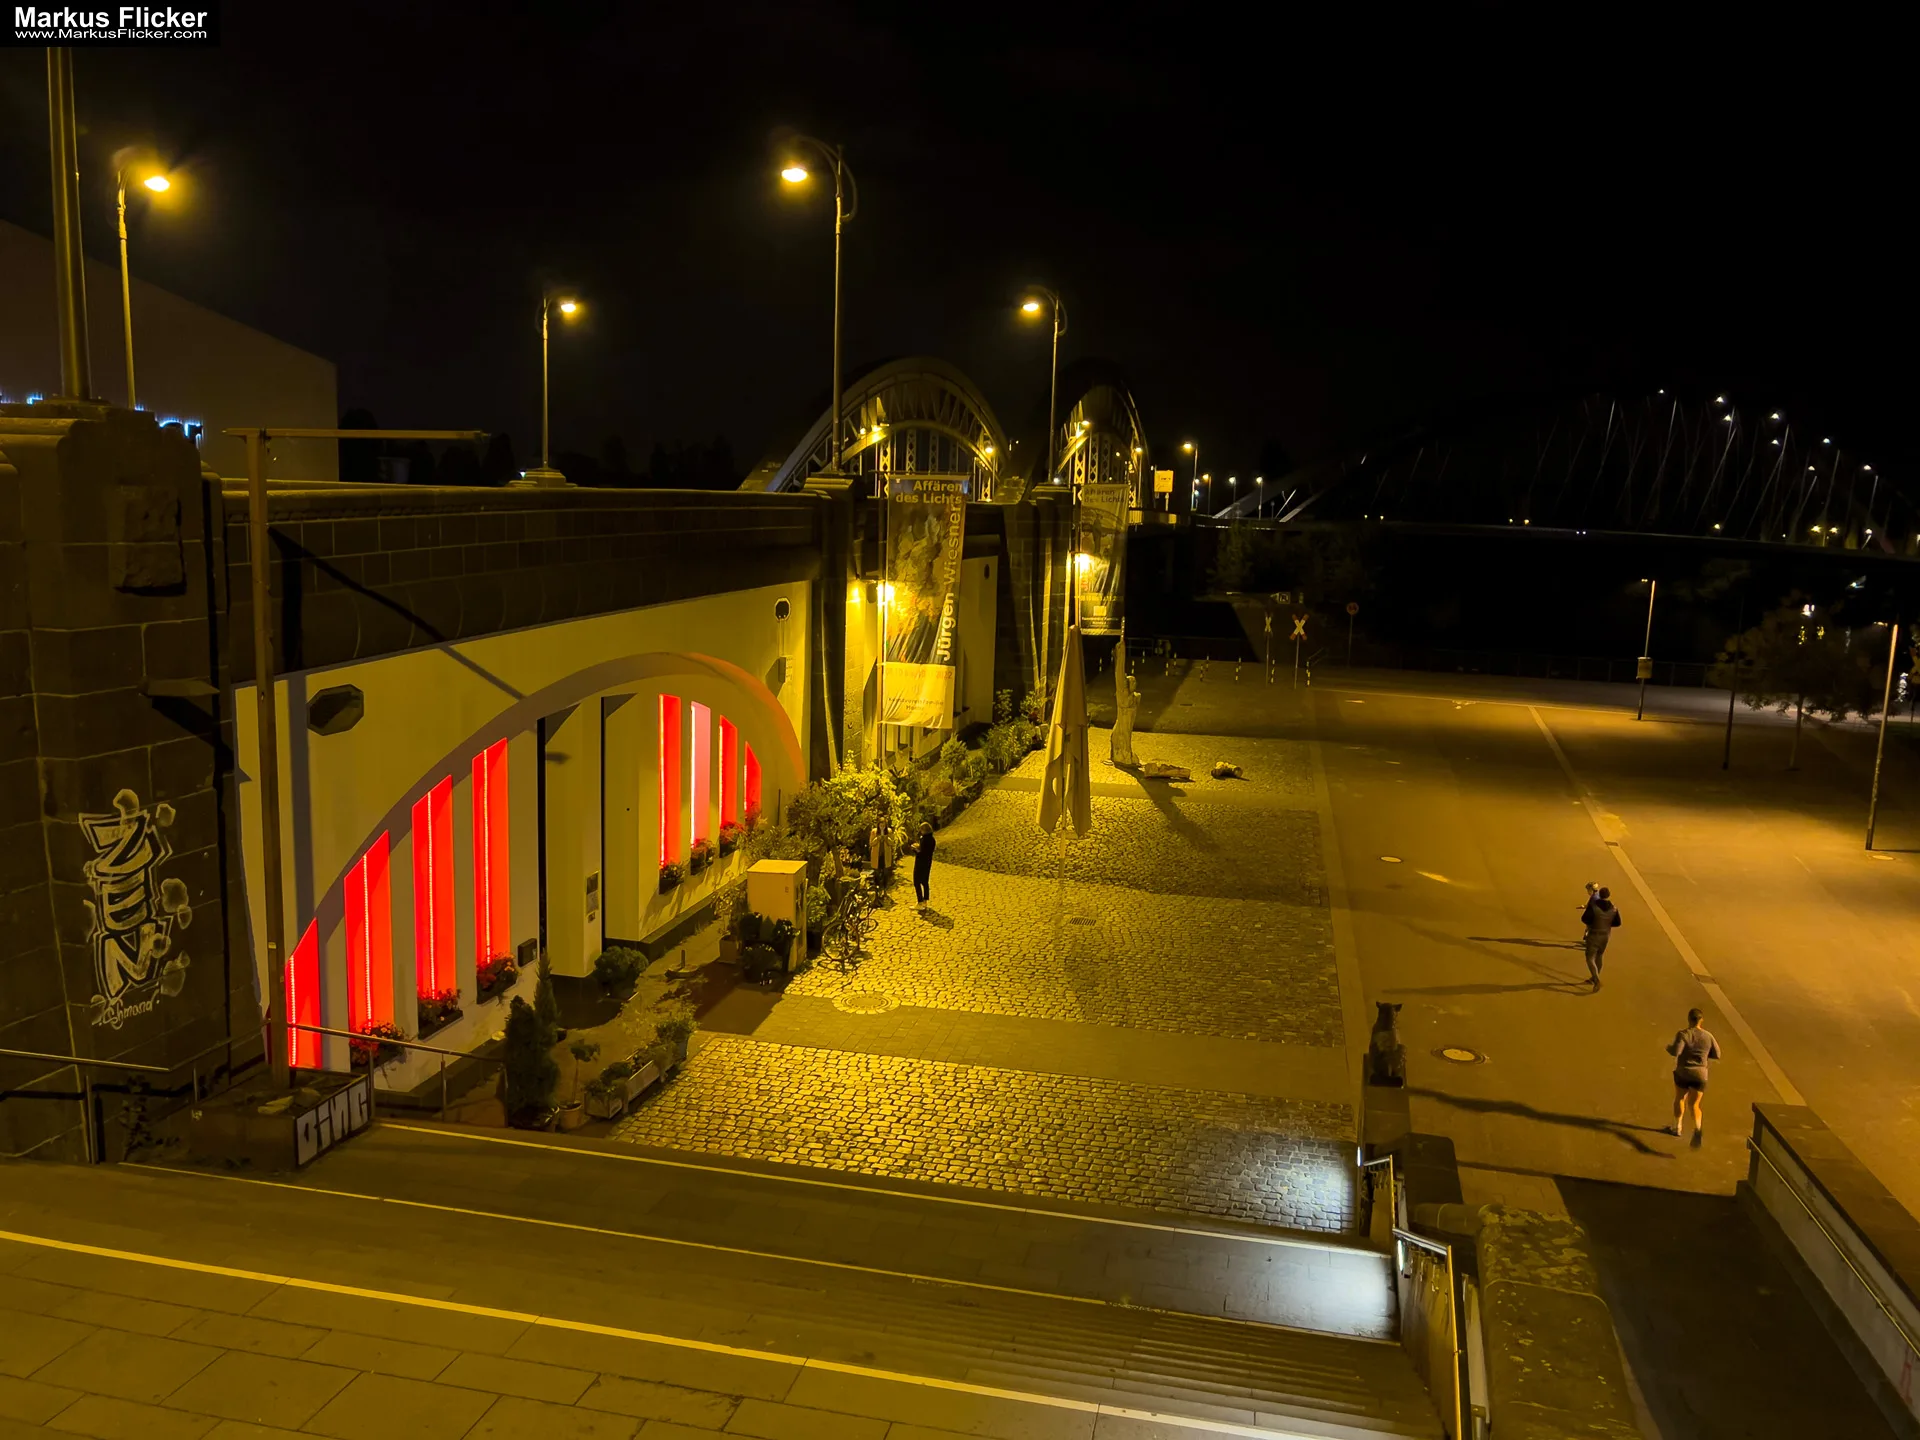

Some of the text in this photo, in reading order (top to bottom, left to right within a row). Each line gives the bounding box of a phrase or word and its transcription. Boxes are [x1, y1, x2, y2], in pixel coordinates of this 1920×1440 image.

[896, 493, 962, 505] des Lichts
[913, 480, 962, 492] Affären
[937, 503, 961, 661] Jürgen Wiesner
[82, 812, 163, 1000] ZEN
